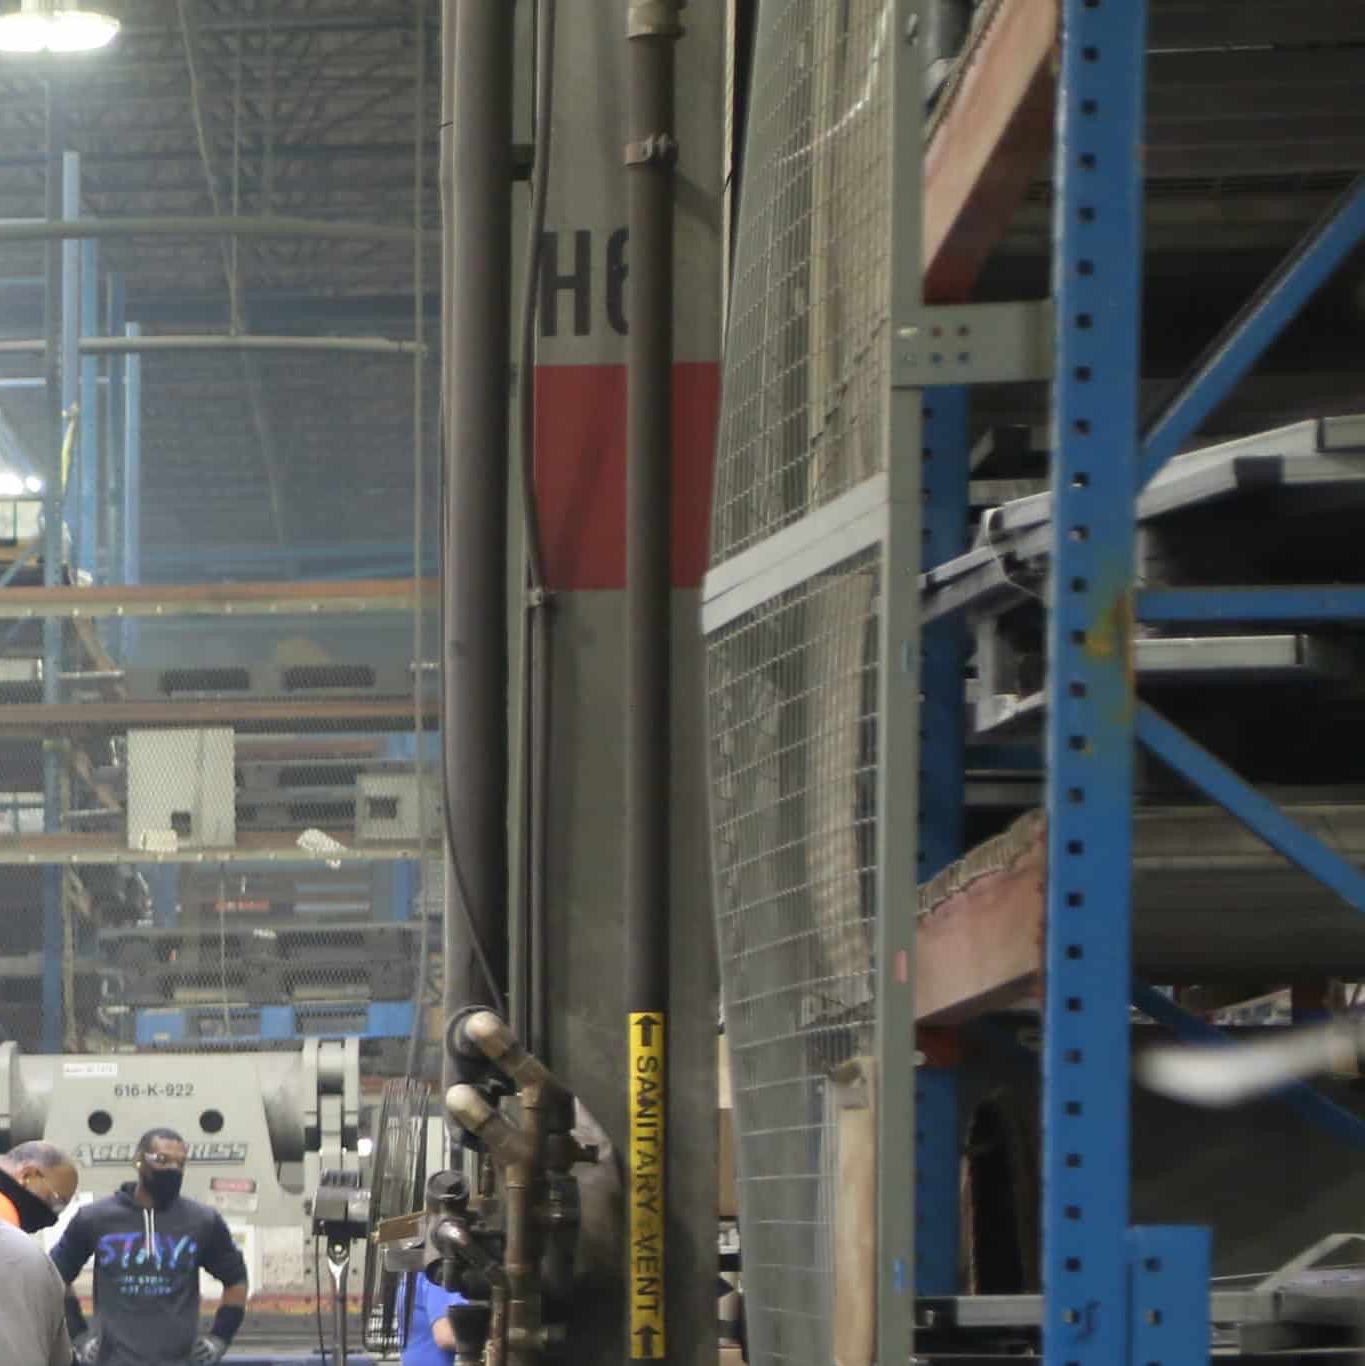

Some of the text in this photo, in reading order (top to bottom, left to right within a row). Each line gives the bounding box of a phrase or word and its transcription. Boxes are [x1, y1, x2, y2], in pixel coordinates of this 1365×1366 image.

[114, 1083, 195, 1098] 616-K-922
[635, 1054, 660, 1318] SANITARY VENT
